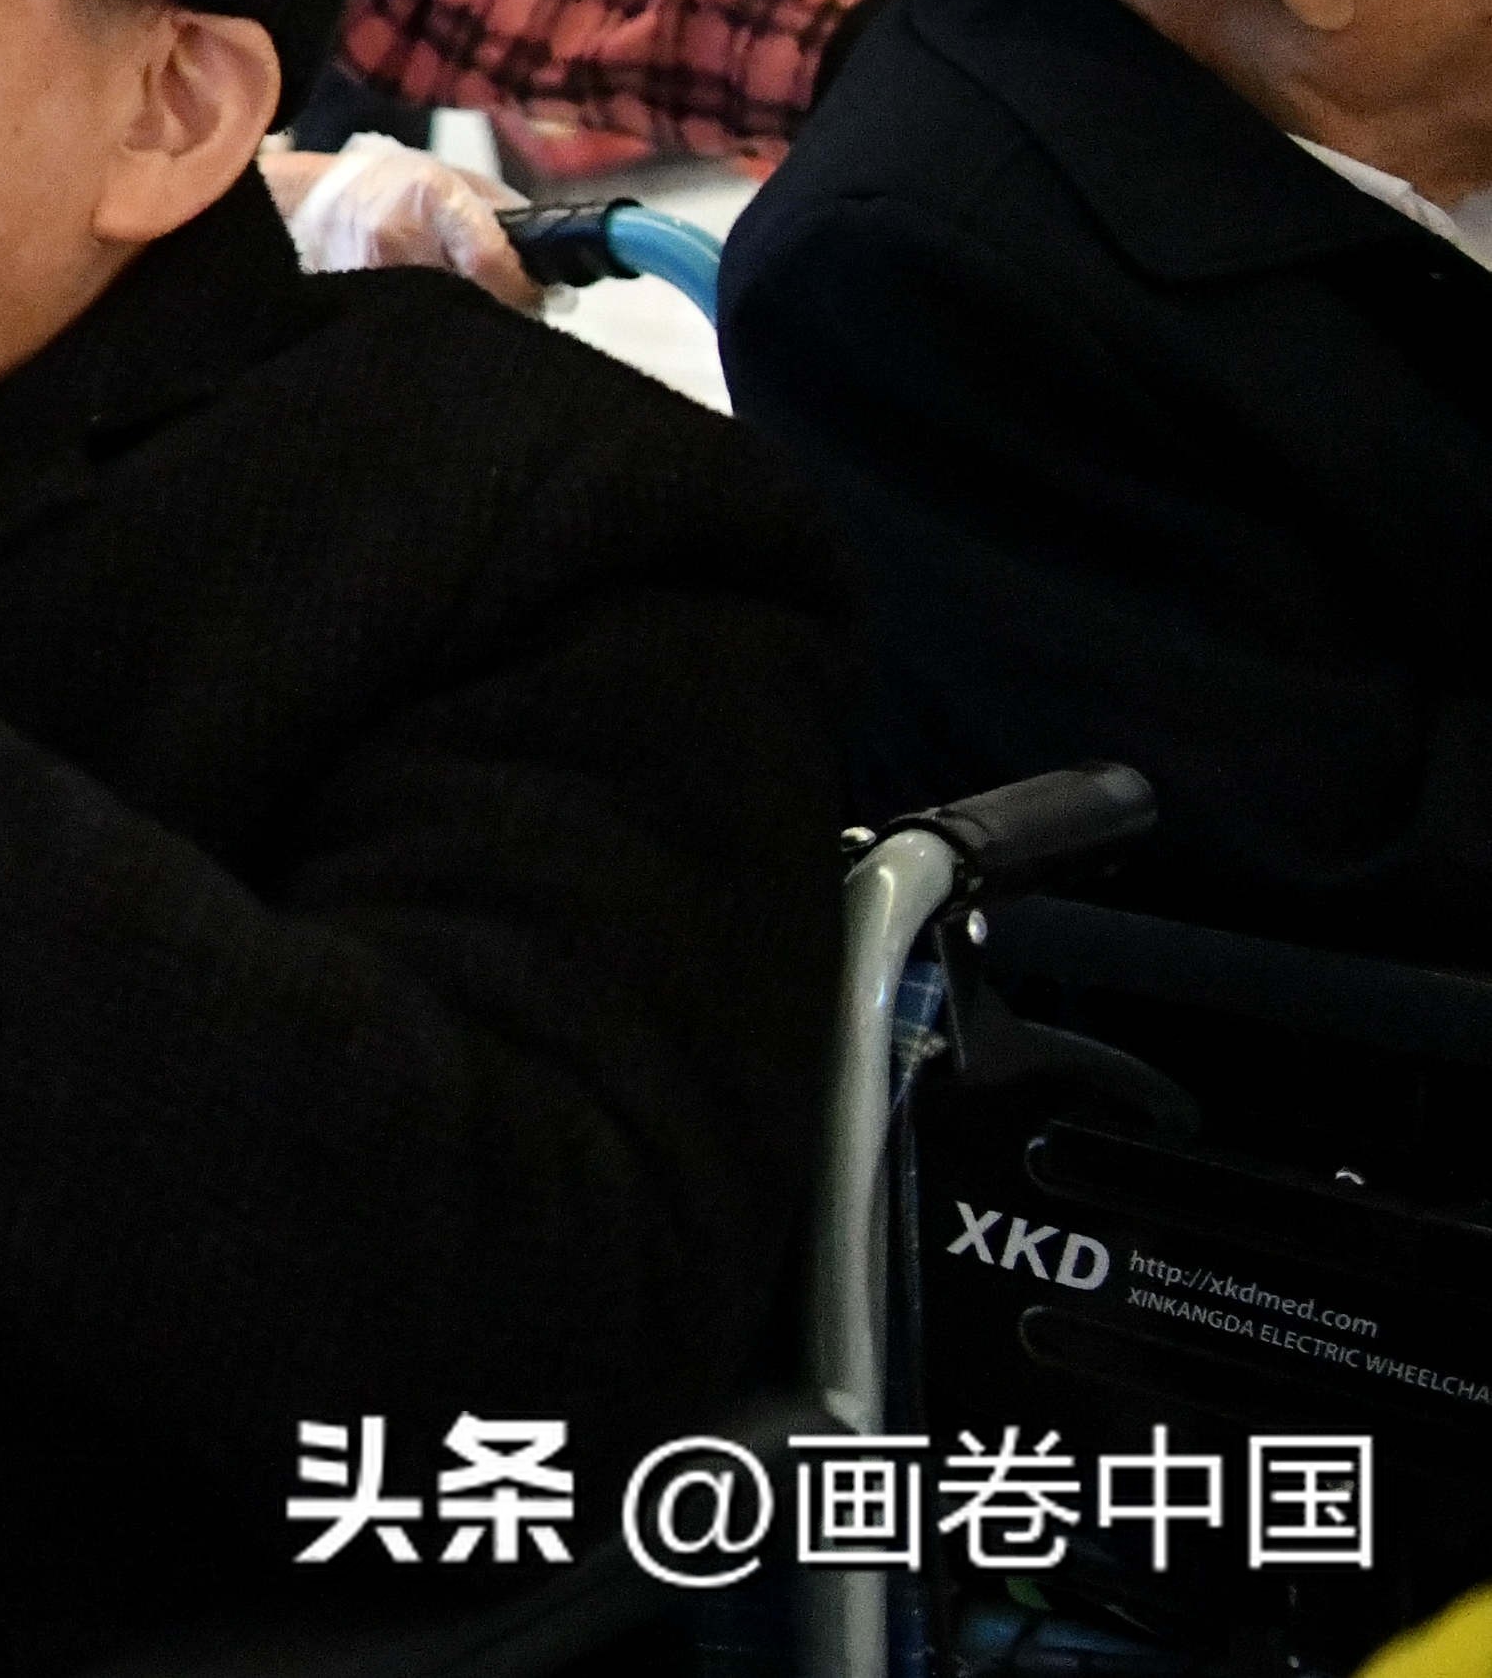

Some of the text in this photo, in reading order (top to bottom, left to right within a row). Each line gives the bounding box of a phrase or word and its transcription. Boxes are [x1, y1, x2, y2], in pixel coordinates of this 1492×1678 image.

[946, 1200, 1110, 1291] XKD
[1127, 1286, 1254, 1339] XINKANGDA
[1260, 1323, 1361, 1368] ELECTRIC
[1130, 1250, 1379, 1338] http://xkdmed.com
